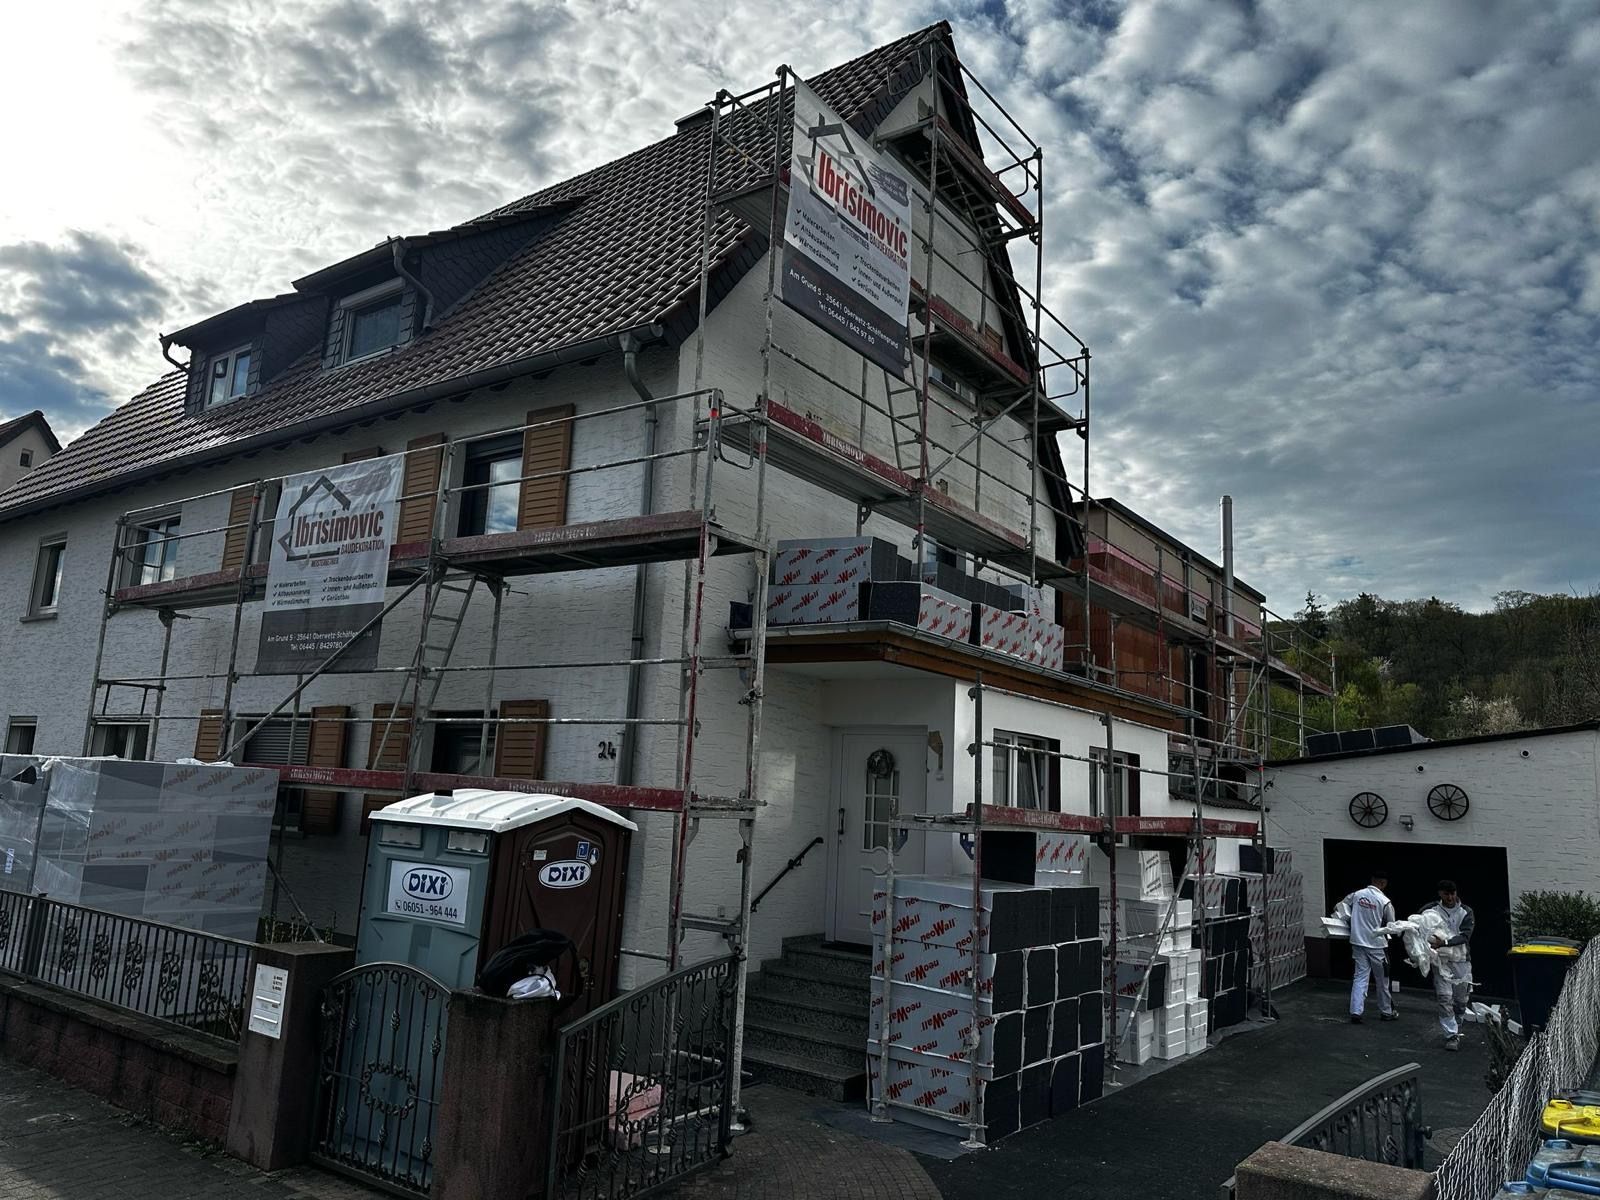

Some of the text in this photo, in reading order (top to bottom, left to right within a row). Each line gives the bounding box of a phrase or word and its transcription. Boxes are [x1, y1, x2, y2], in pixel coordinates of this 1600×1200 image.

[818, 152, 908, 258] Ibrisimovic
[789, 268, 800, 281] Am
[800, 275, 817, 293] Grund
[825, 293, 842, 310] 35641
[827, 307, 846, 325] 06445
[849, 322, 860, 335] 842
[295, 503, 384, 548] Ibrisimovic
[791, 590, 819, 613] neoWall
[818, 588, 847, 612] neoWall
[299, 642, 315, 651] 06445
[598, 741, 617, 760] 24
[444, 906, 458, 919] 444
[920, 918, 957, 943] neoWall
[904, 959, 940, 983] neoWall
[922, 1008, 959, 1032] neoWall
[914, 1086, 947, 1108] neoWall
